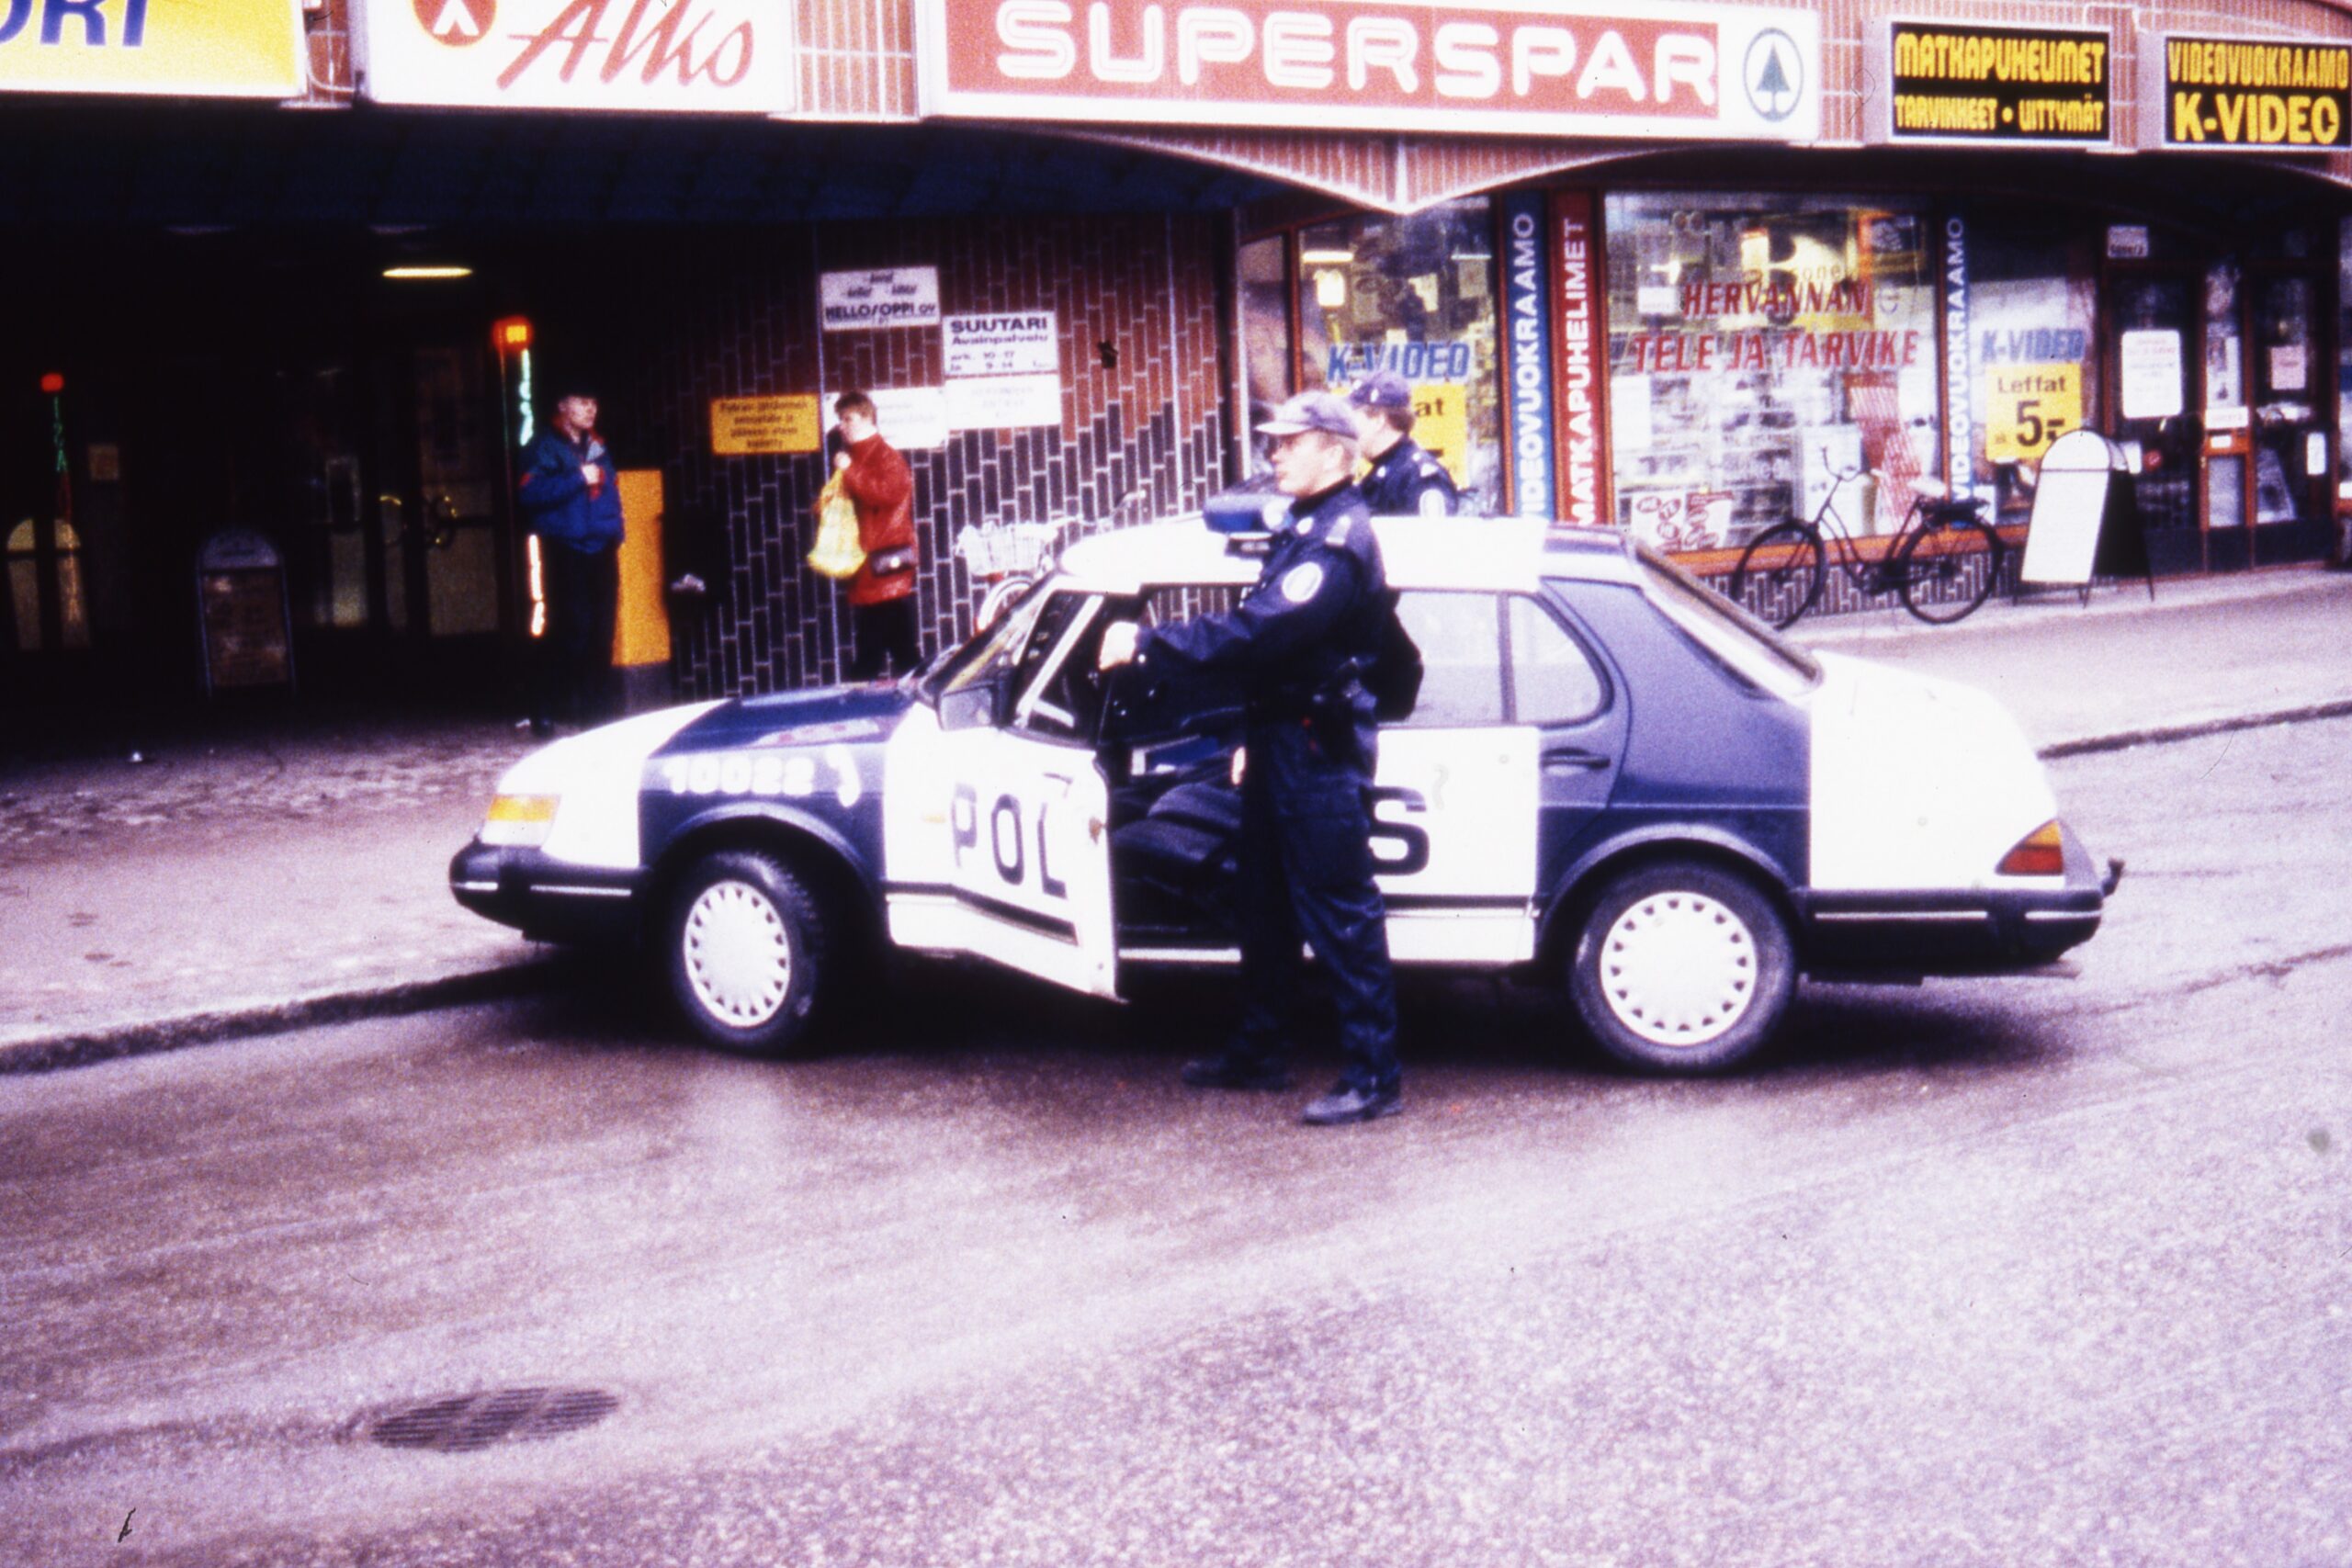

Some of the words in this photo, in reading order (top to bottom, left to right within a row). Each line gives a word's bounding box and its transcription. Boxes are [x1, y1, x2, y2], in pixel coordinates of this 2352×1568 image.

[996, 0, 1716, 106] SUPERSPAR
[1894, 32, 2105, 84] MATKAPUHELIMET
[2167, 41, 2349, 89] VIDEOVUOKRAAMO
[1894, 95, 1998, 130] TARVIKKEET
[2174, 92, 2341, 145] K-VIDEO
[1682, 280, 1869, 317] HERVANNAN
[950, 317, 1047, 333] SUUTARI
[952, 333, 1048, 345] Avainpalvelu
[1982, 329, 2085, 362] K-VIDEO
[1327, 341, 1470, 382] K-VIDEO
[1633, 333, 1716, 373] TELE
[1726, 333, 1765, 369] JA
[1783, 330, 1919, 369] TARVIKE
[1946, 218, 1973, 501] VIDEOVUOKRAAMO
[1997, 376, 2066, 394] Leffat
[662, 753, 815, 795] 10022
